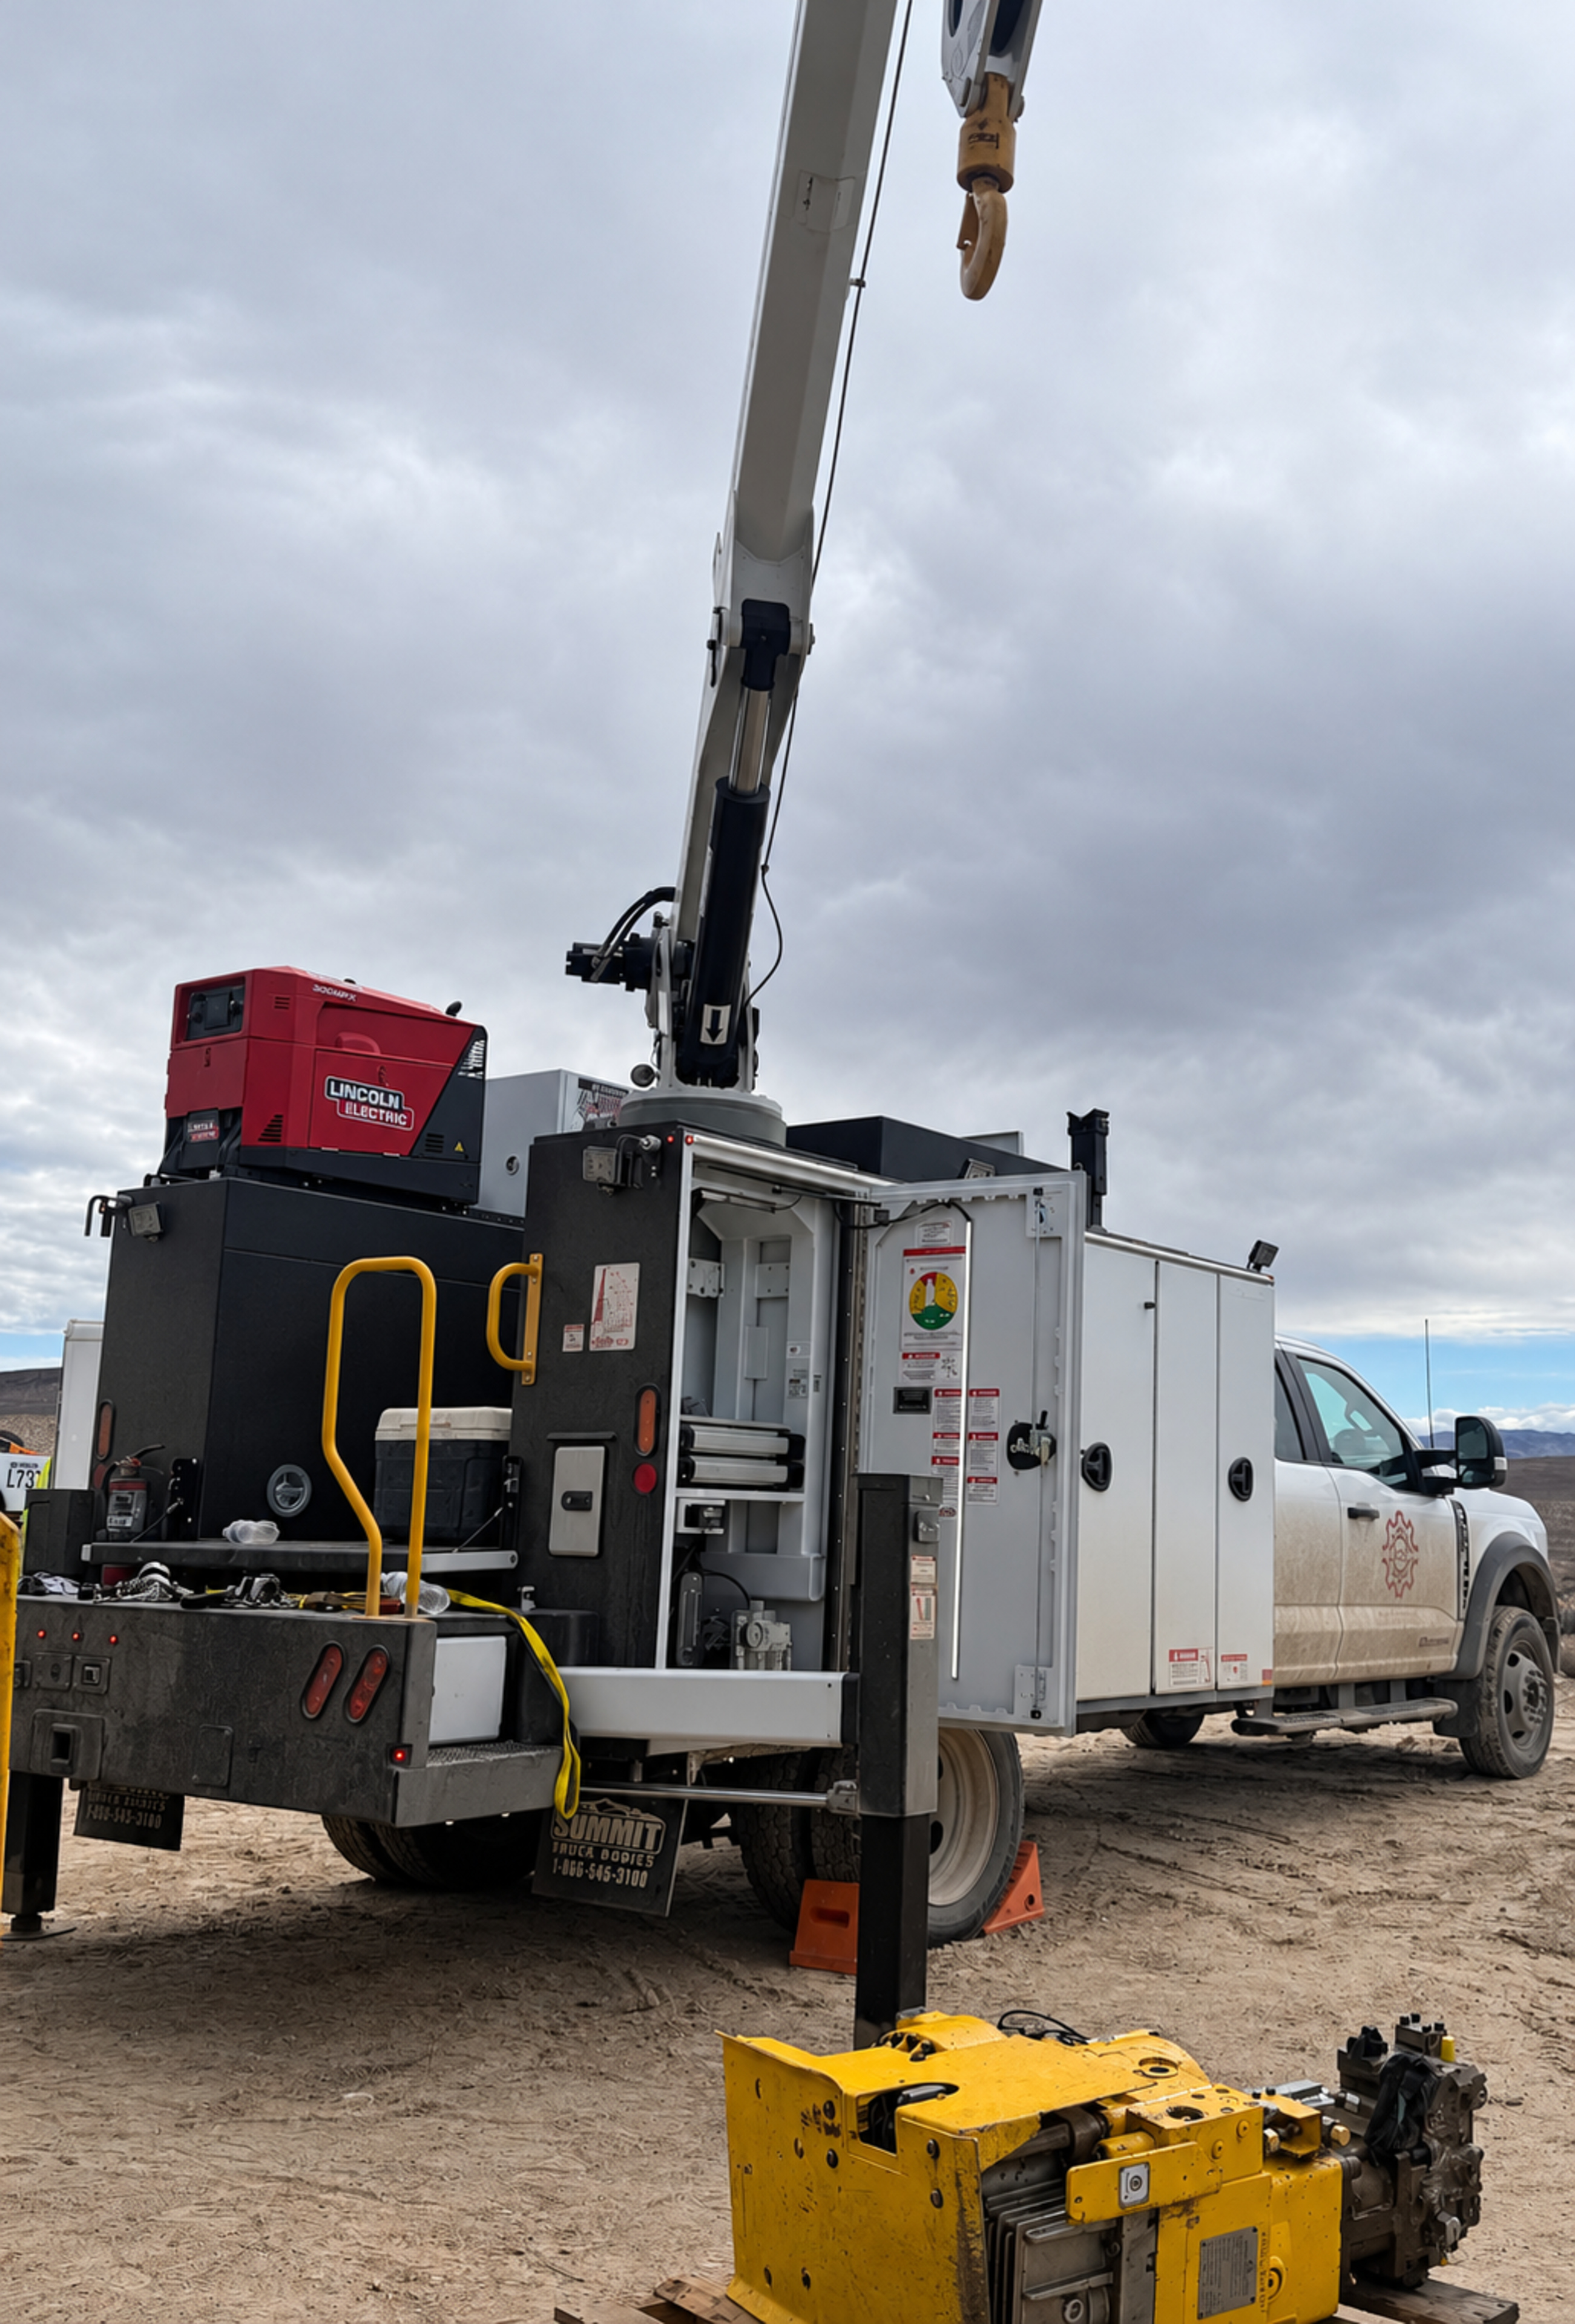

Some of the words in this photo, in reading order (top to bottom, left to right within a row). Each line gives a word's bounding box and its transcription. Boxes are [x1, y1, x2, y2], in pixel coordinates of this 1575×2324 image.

[330, 1081, 400, 1109] LINCOLN
[345, 1101, 407, 1126] ELECTRIC
[6, 1469, 41, 1488] L73
[553, 1814, 662, 1851] SUMMIT
[552, 1841, 594, 1859] TRUCK
[600, 1848, 655, 1868] BODIES
